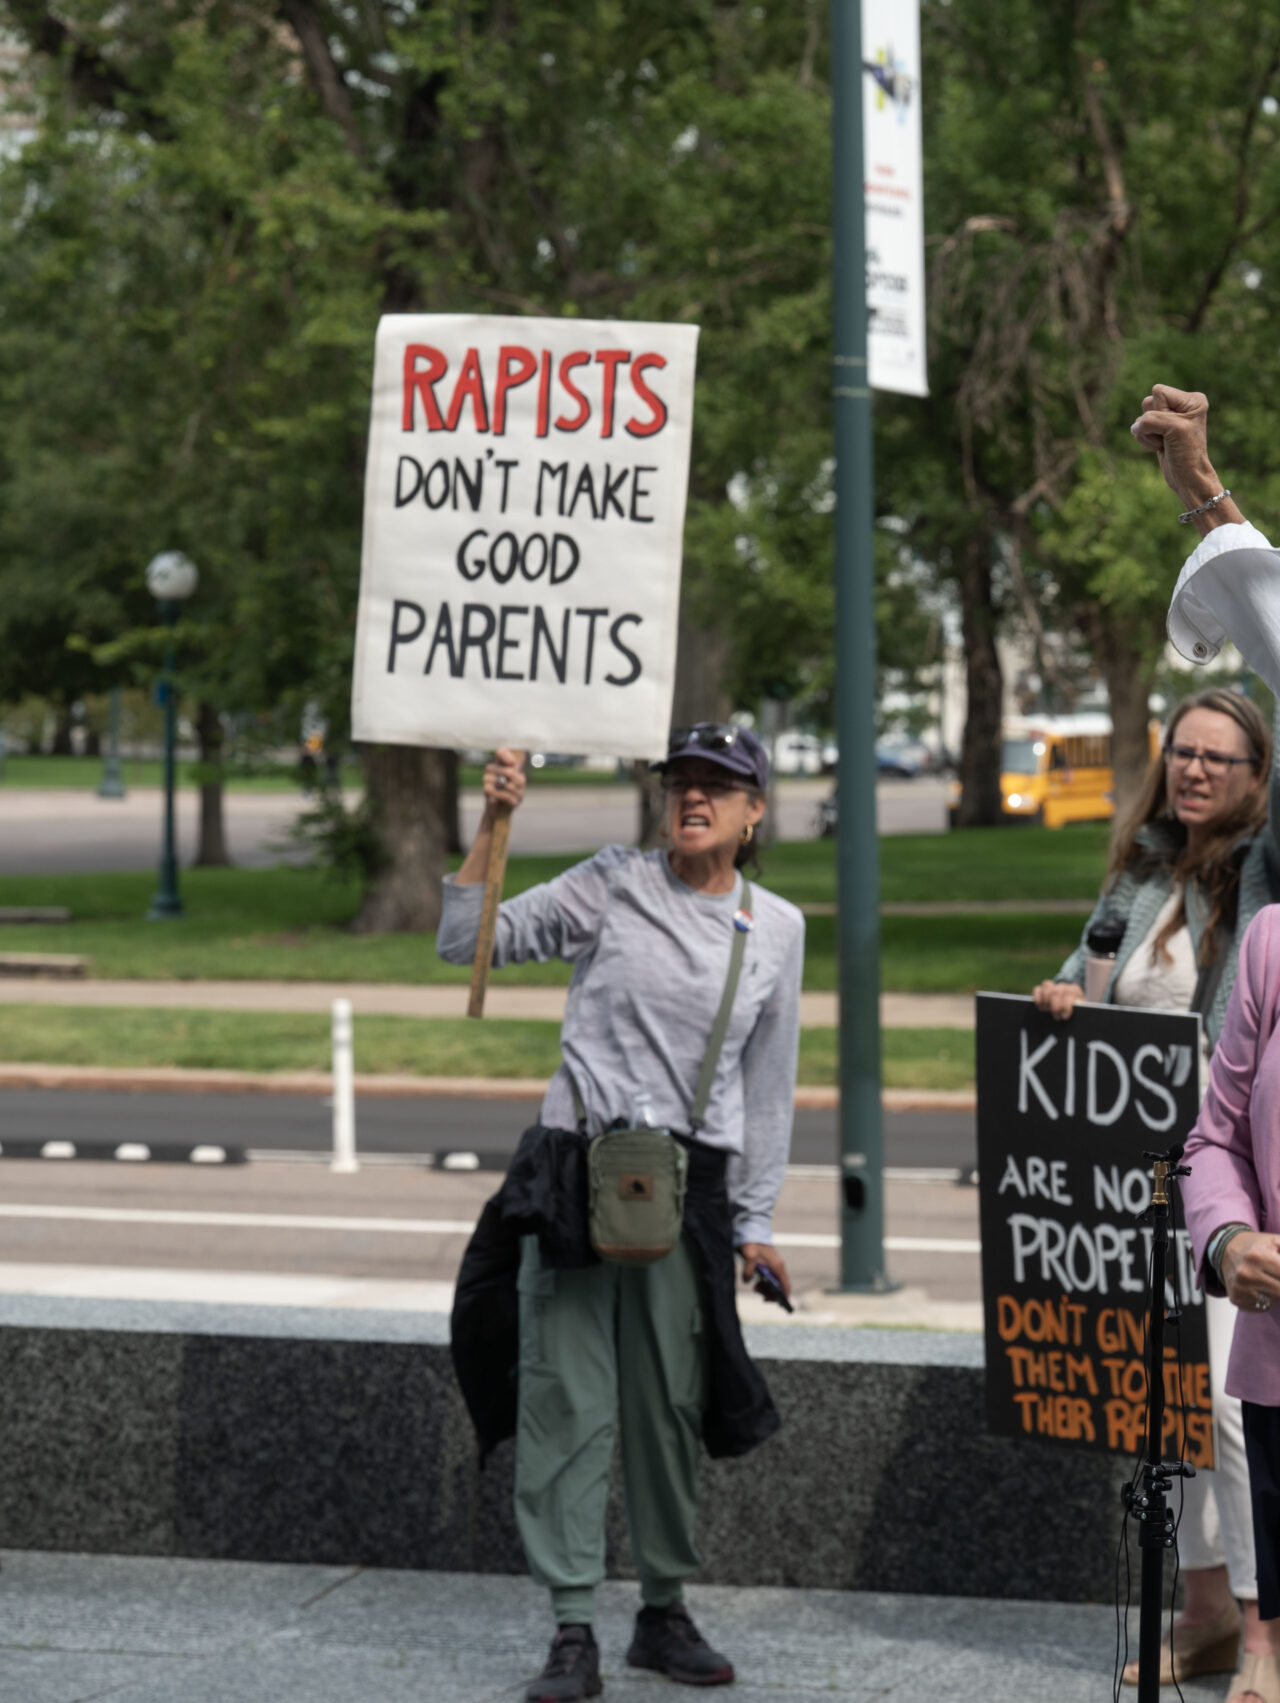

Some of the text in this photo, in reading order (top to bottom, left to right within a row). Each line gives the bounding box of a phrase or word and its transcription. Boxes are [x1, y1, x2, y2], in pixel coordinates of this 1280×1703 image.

[402, 343, 669, 440] RAPISTS
[394, 447, 658, 524] DON'T MAKE
[456, 528, 581, 586] GOOD
[386, 598, 644, 687] PARENTS
[998, 1155, 1177, 1215] ARE NO
[997, 1294, 1087, 1346] DON'T
[1005, 1346, 1099, 1396] THEM
[1101, 1357, 1150, 1404] TO
